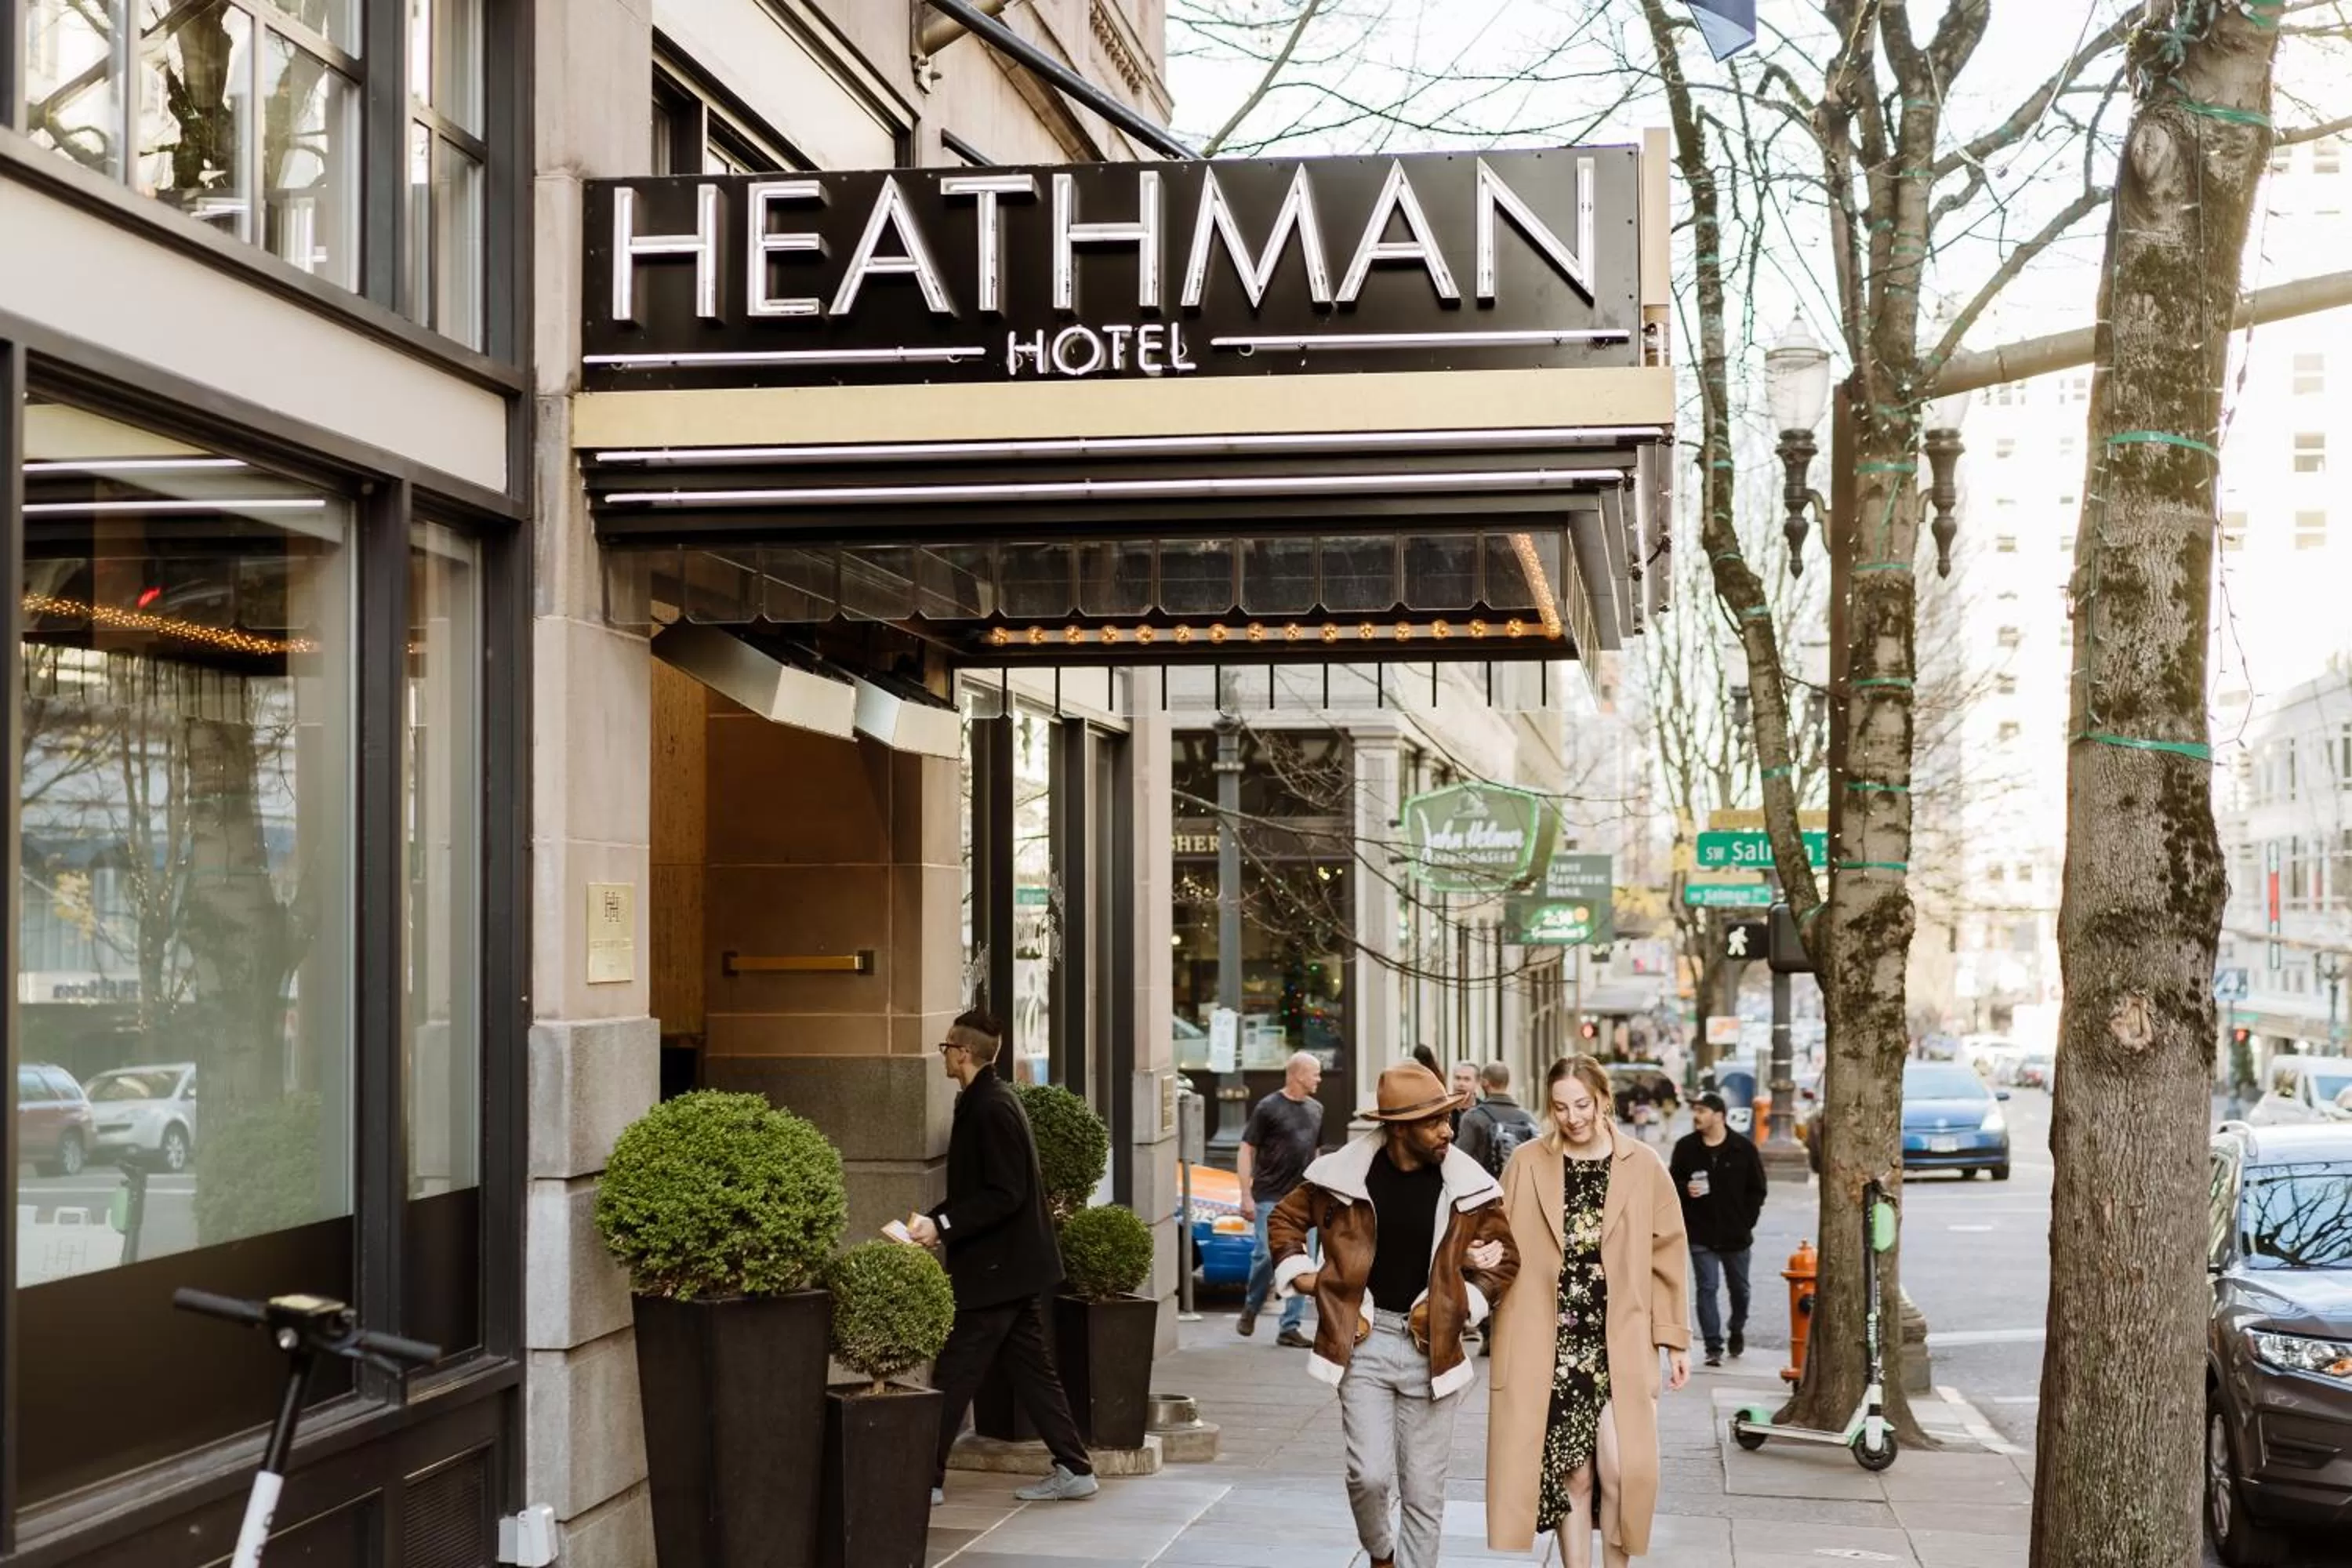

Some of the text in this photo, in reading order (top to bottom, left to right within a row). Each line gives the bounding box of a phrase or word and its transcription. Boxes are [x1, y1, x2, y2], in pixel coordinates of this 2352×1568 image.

[612, 158, 1595, 321] HEATHMAN
[1006, 322, 1196, 376] HOTEL
[1705, 846, 1725, 860] SW
